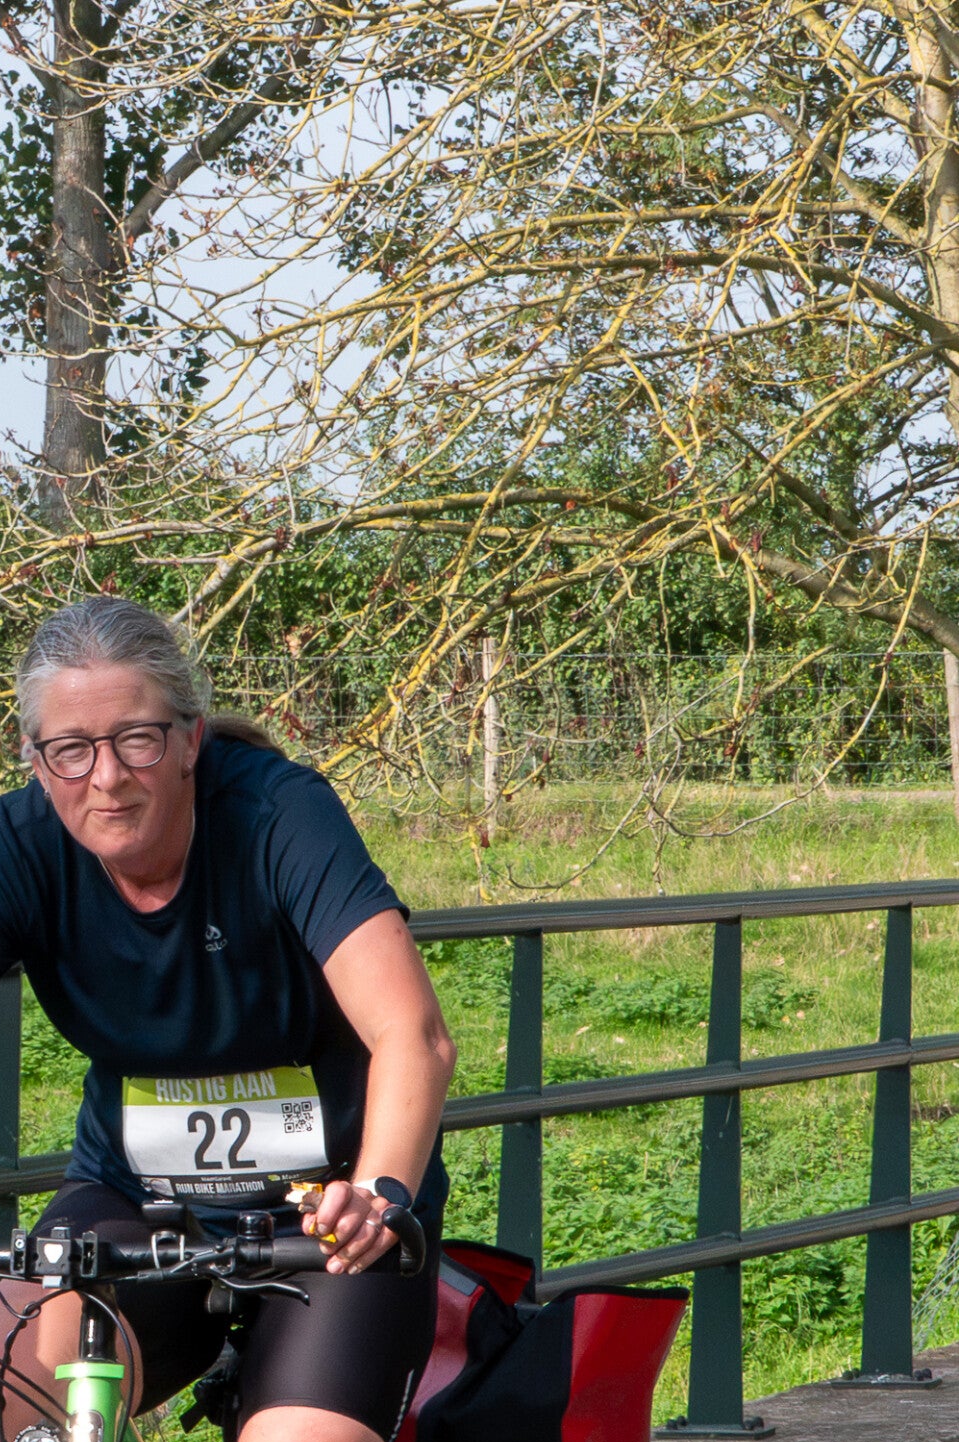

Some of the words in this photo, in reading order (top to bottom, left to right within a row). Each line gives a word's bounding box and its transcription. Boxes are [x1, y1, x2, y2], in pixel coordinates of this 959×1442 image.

[155, 1078, 227, 1103] RUSTIG
[233, 1071, 277, 1099] AAN
[187, 1107, 257, 1170] 22
[175, 1182, 194, 1194] RUN
[194, 1182, 215, 1194] BIKE
[216, 1181, 265, 1194] MARATHON
